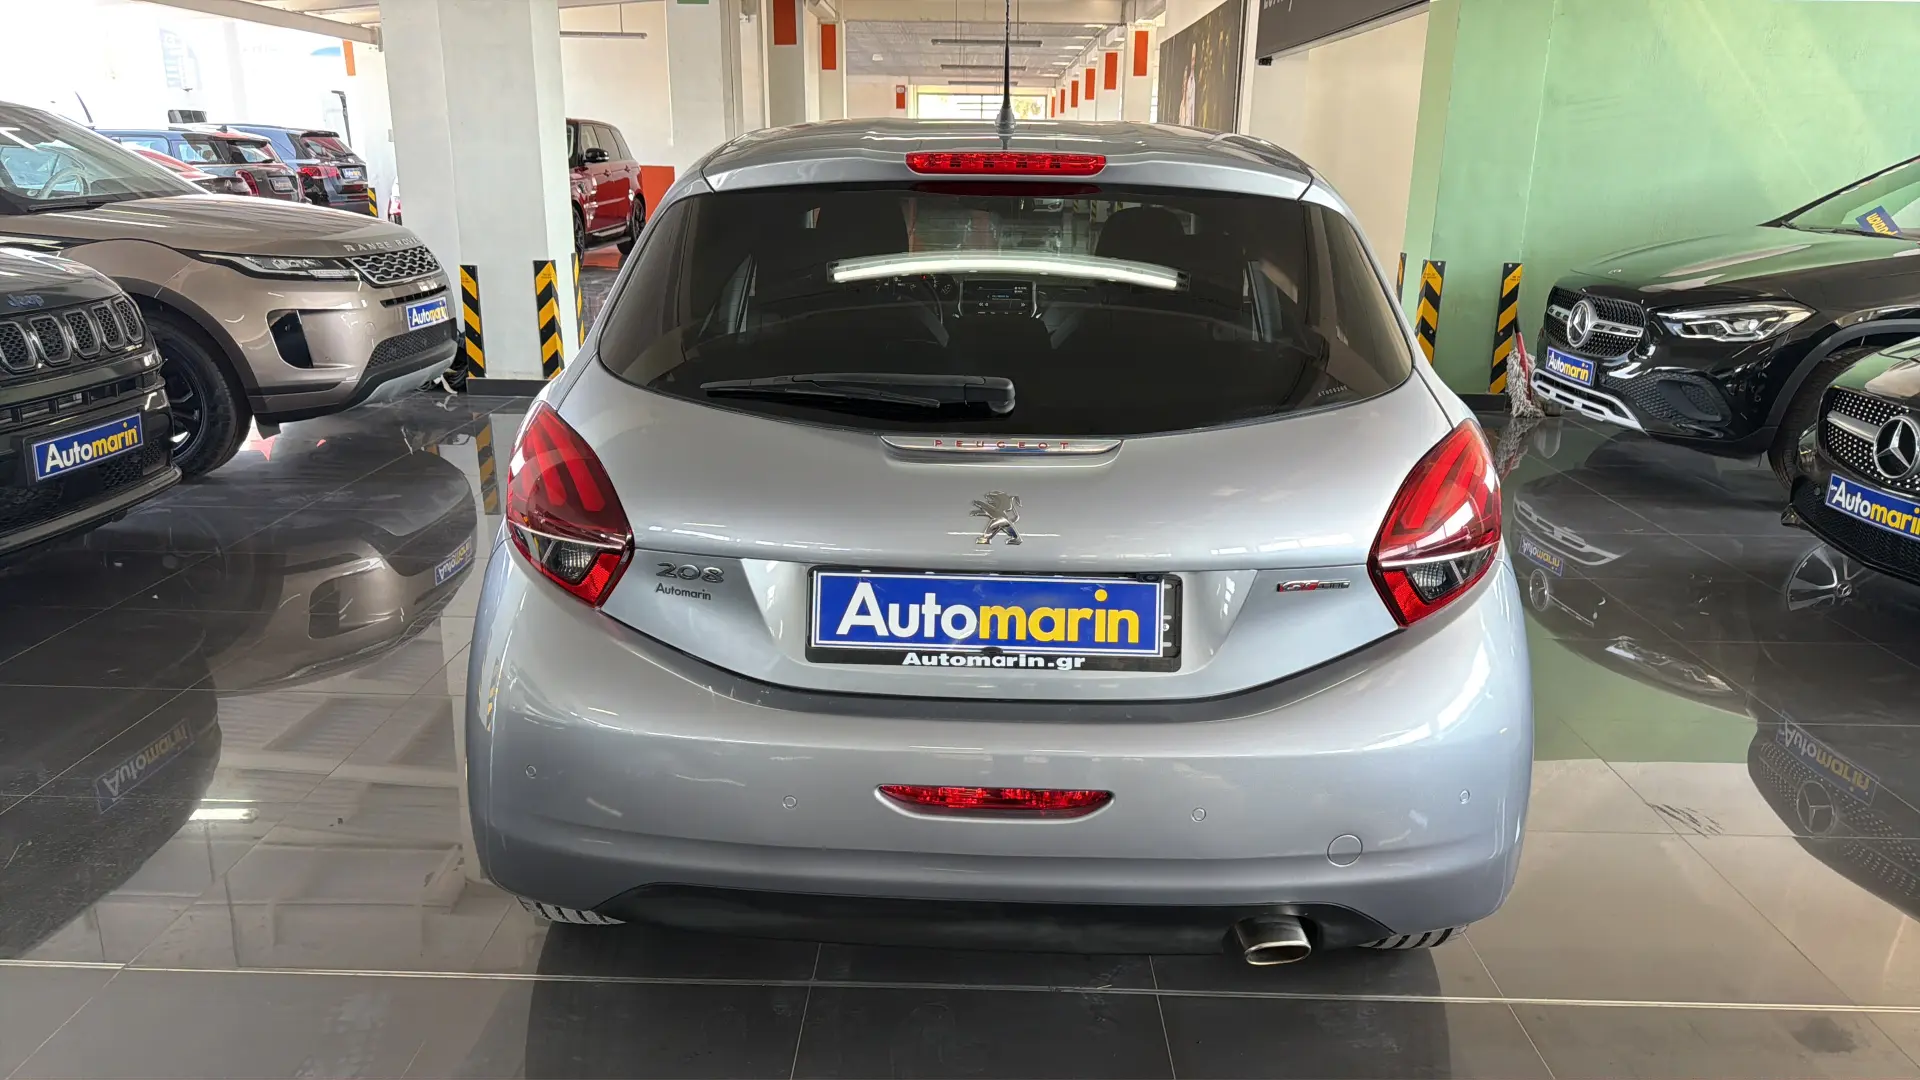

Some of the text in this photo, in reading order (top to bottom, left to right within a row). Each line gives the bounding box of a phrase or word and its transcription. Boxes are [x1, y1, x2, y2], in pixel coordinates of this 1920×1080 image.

[343, 241, 393, 253] RANGE
[7, 293, 45, 308] Jeep
[1548, 351, 1590, 382] Automarin
[45, 421, 139, 474] Automarin
[933, 439, 1069, 450] PEUGEOT
[1831, 480, 1920, 536] Automari
[655, 561, 725, 584] 208
[655, 582, 712, 601] Automarin
[835, 581, 1140, 644] Automarin
[901, 652, 1086, 672] Automarin.gr
